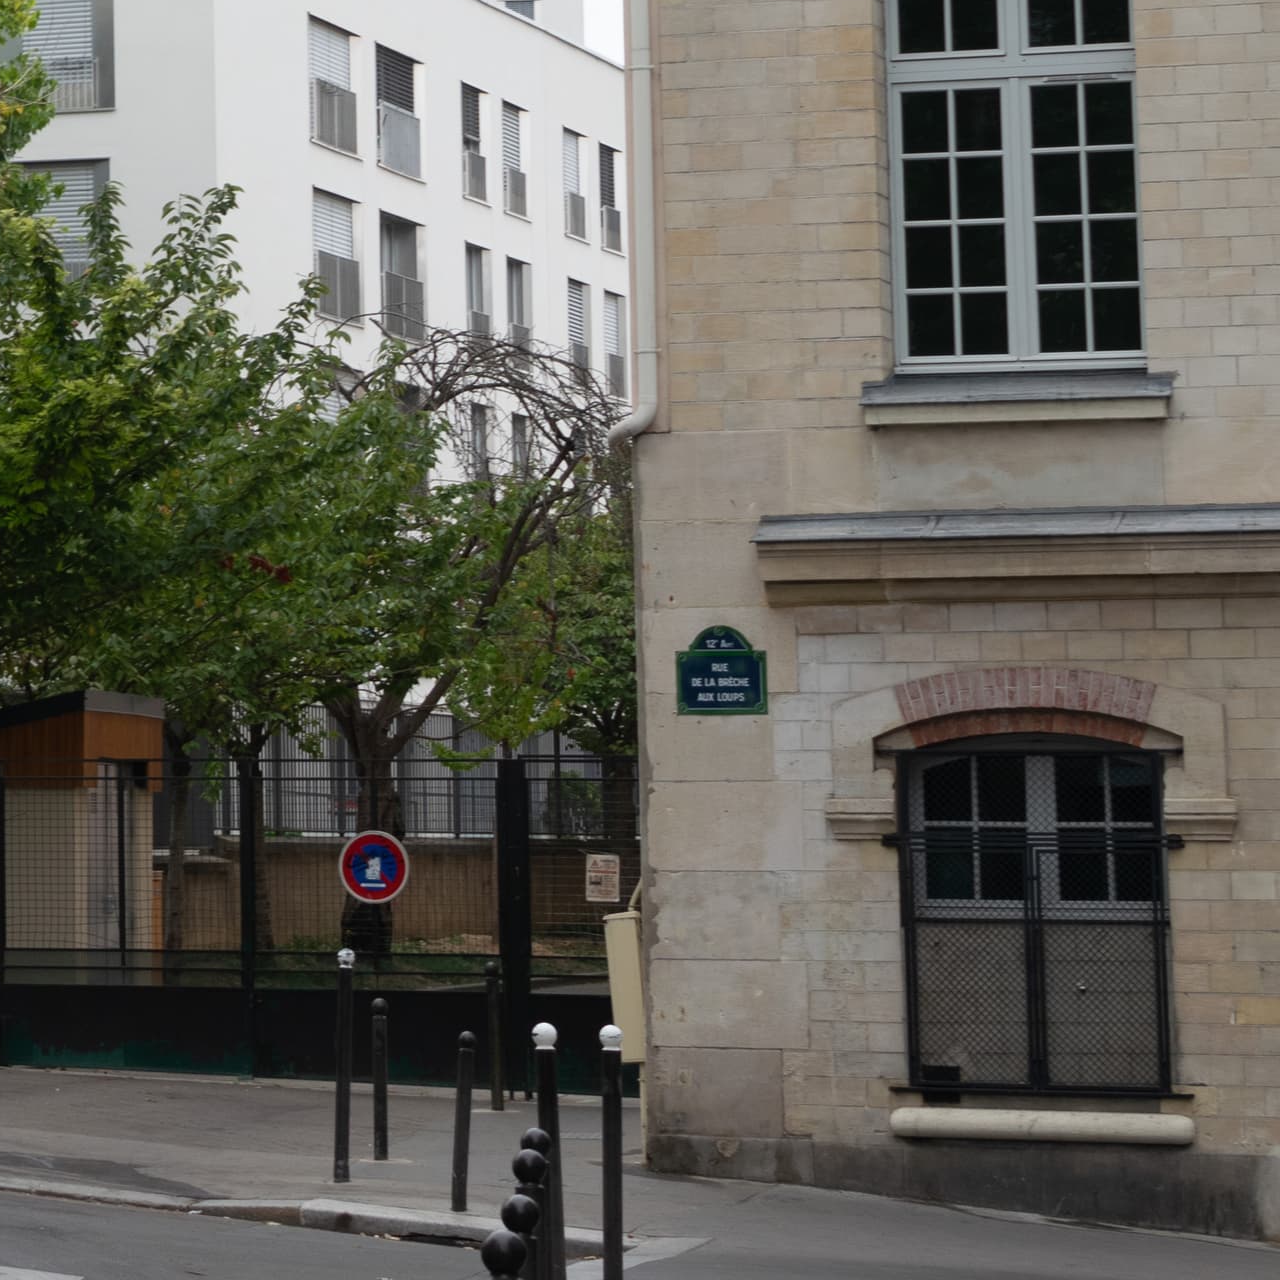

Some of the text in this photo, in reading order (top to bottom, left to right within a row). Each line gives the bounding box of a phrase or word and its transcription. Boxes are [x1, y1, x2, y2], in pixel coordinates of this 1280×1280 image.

[711, 663, 729, 672] RUE
[691, 676, 750, 687] DE LA BRÈCHE
[697, 692, 745, 702] AUX LOUPS
